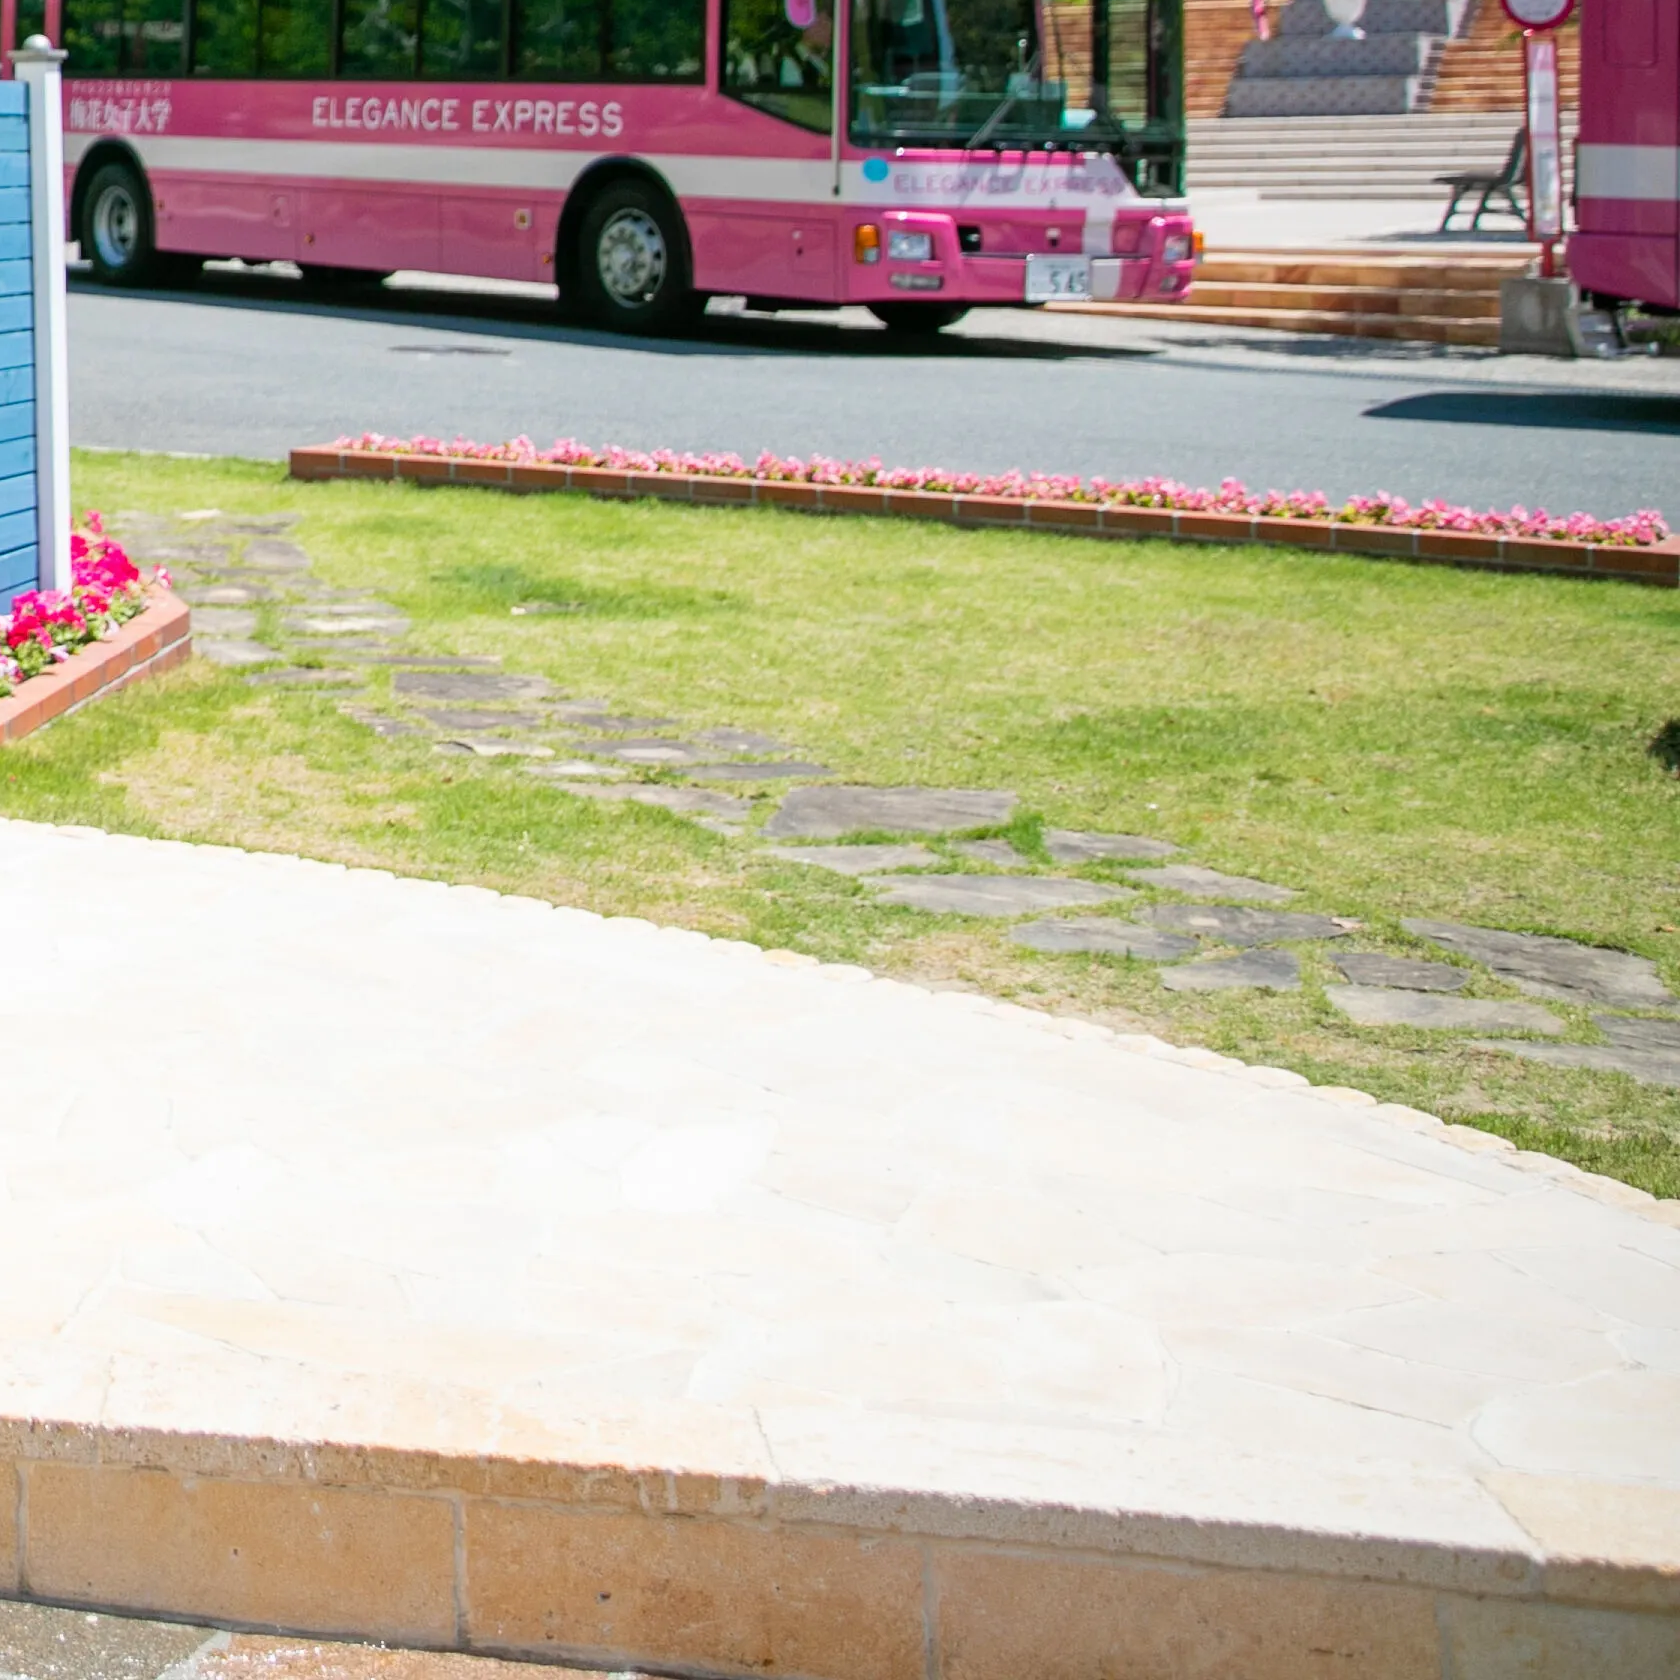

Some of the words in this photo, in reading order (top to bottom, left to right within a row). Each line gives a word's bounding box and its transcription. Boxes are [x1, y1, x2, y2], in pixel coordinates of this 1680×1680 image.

[312, 96, 460, 131] ELEGANCE
[472, 99, 624, 137] EXPRESS
[893, 173, 1014, 196] ELEGANCE
[1024, 175, 1125, 198] EXPRESS
